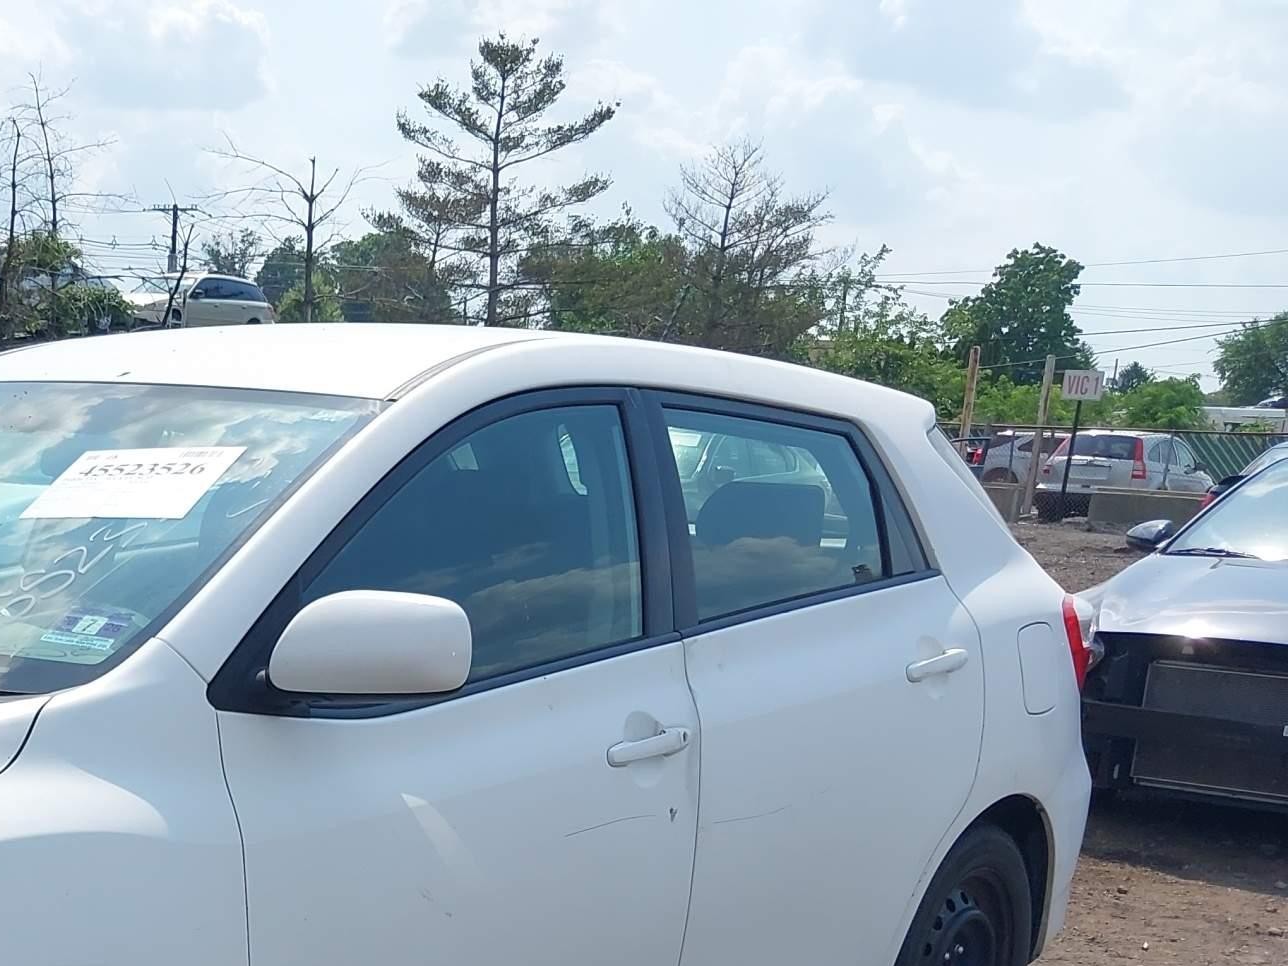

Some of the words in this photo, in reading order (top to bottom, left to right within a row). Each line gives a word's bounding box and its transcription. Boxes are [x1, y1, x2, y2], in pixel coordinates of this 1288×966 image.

[1067, 375, 1090, 396] VIC
[1094, 375, 1100, 396] 1
[79, 461, 209, 477] 45523526
